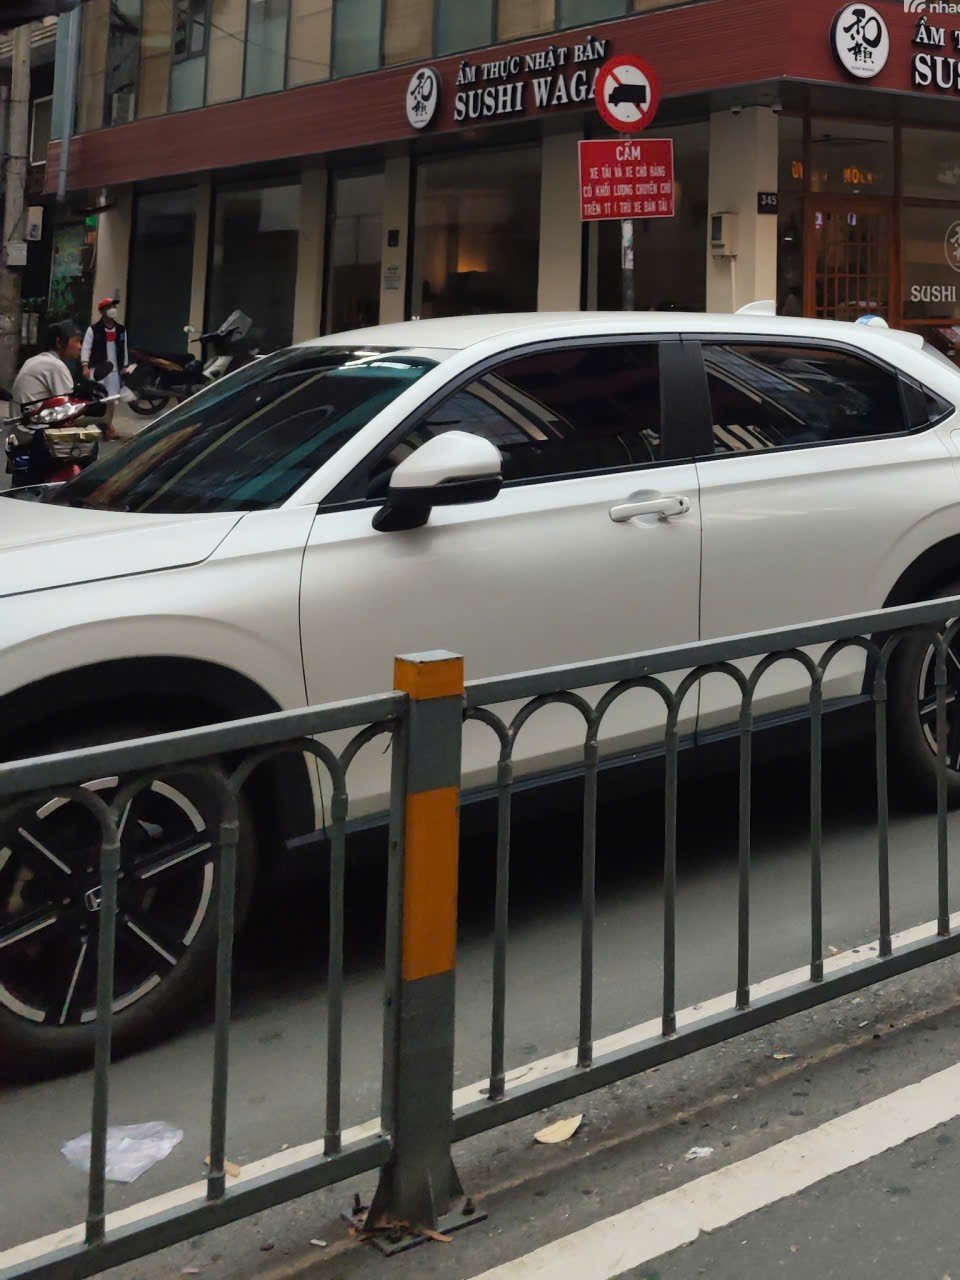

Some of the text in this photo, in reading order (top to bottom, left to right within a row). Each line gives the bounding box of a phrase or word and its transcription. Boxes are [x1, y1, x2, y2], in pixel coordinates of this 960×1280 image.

[915, 17, 946, 47] ẨM
[455, 35, 607, 86] ẨM THỰC NHẬT BẢN
[454, 68, 601, 121] SUSHI WAGA
[616, 141, 641, 161] CẤM
[590, 167, 599, 179] XE
[625, 166, 633, 178] XE
[634, 200, 642, 213] XE
[760, 194, 777, 206] 345
[910, 285, 956, 303] SUSHI
